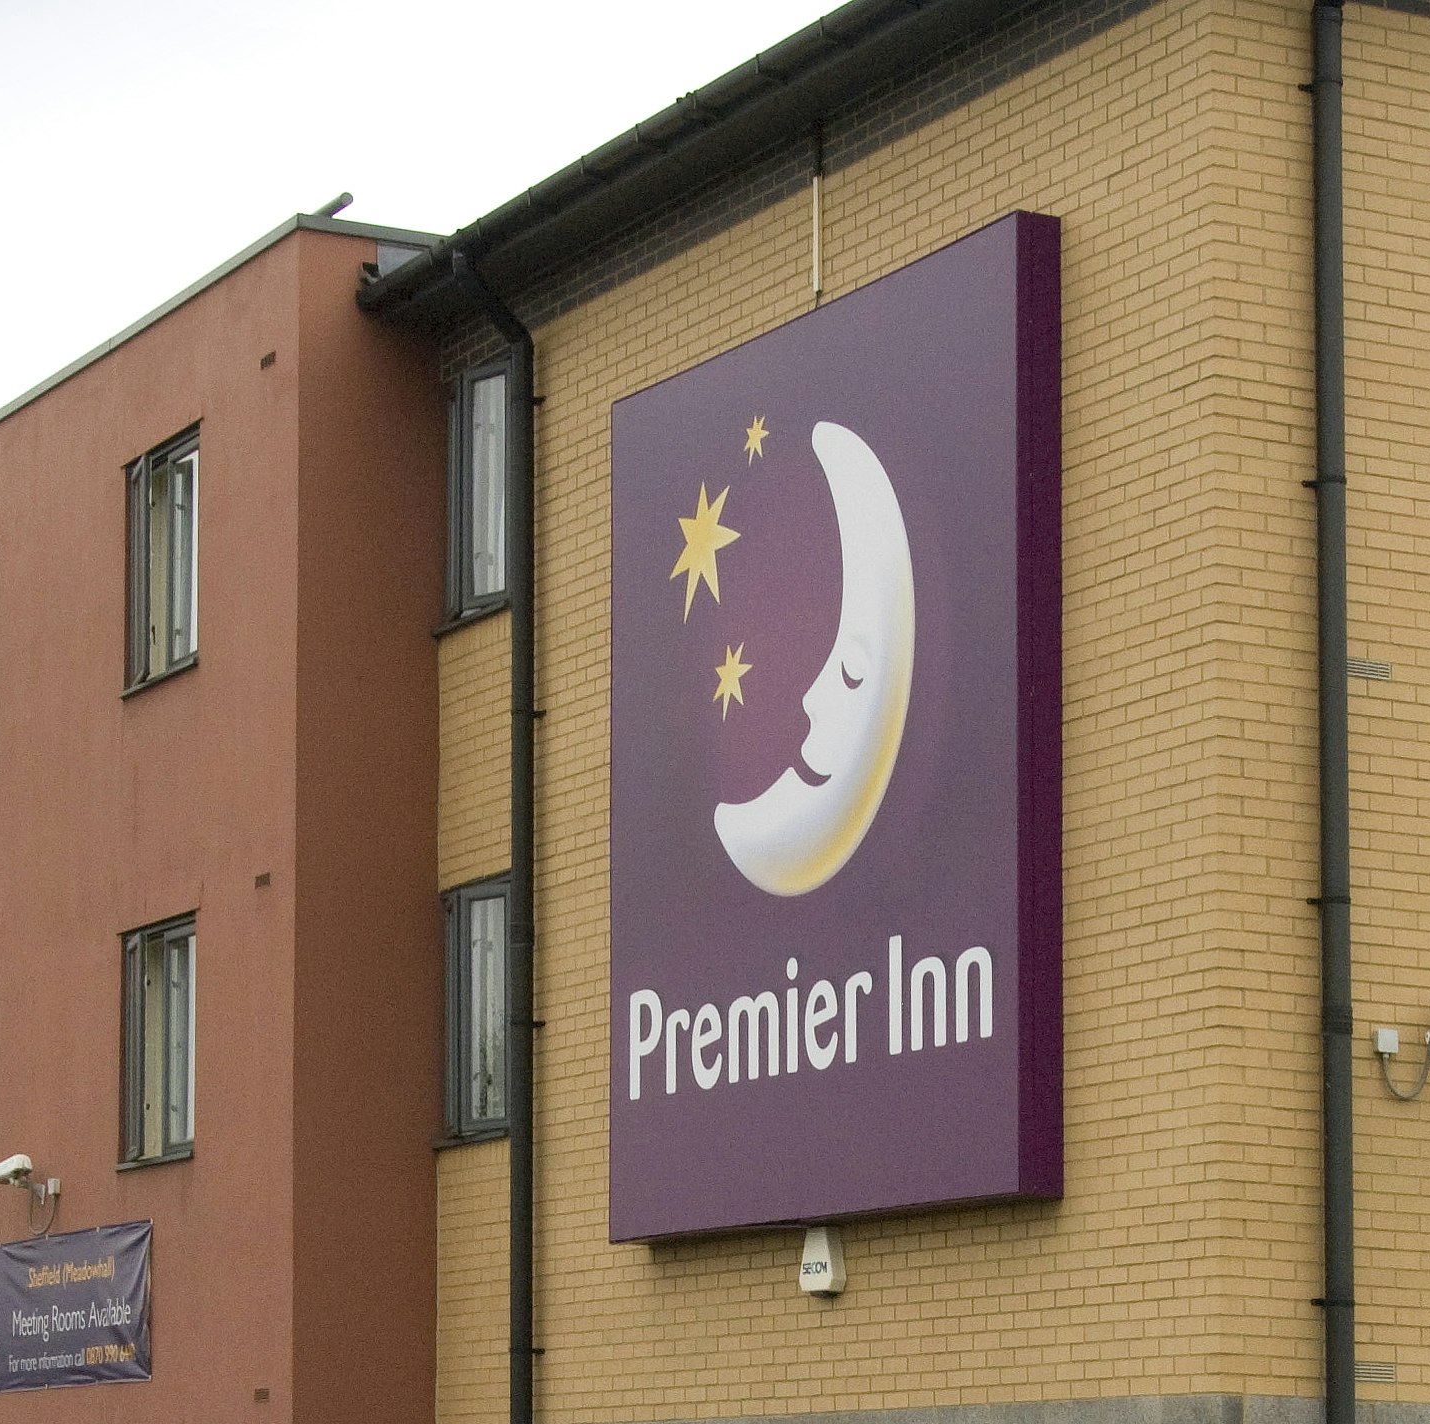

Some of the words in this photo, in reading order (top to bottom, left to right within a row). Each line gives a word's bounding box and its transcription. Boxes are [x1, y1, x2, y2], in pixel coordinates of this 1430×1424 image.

[628, 956, 873, 1101] Premier
[887, 934, 994, 1056] Inn
[27, 1263, 61, 1288] Sheffield
[63, 1255, 115, 1289] (Meadowhall)
[802, 1261, 828, 1275] SECOM
[11, 1308, 50, 1342] Meeting
[51, 1305, 86, 1332] Rooms
[88, 1297, 131, 1328] Available
[8, 1354, 20, 1373] For
[20, 1356, 37, 1372] more
[74, 1348, 85, 1367] call
